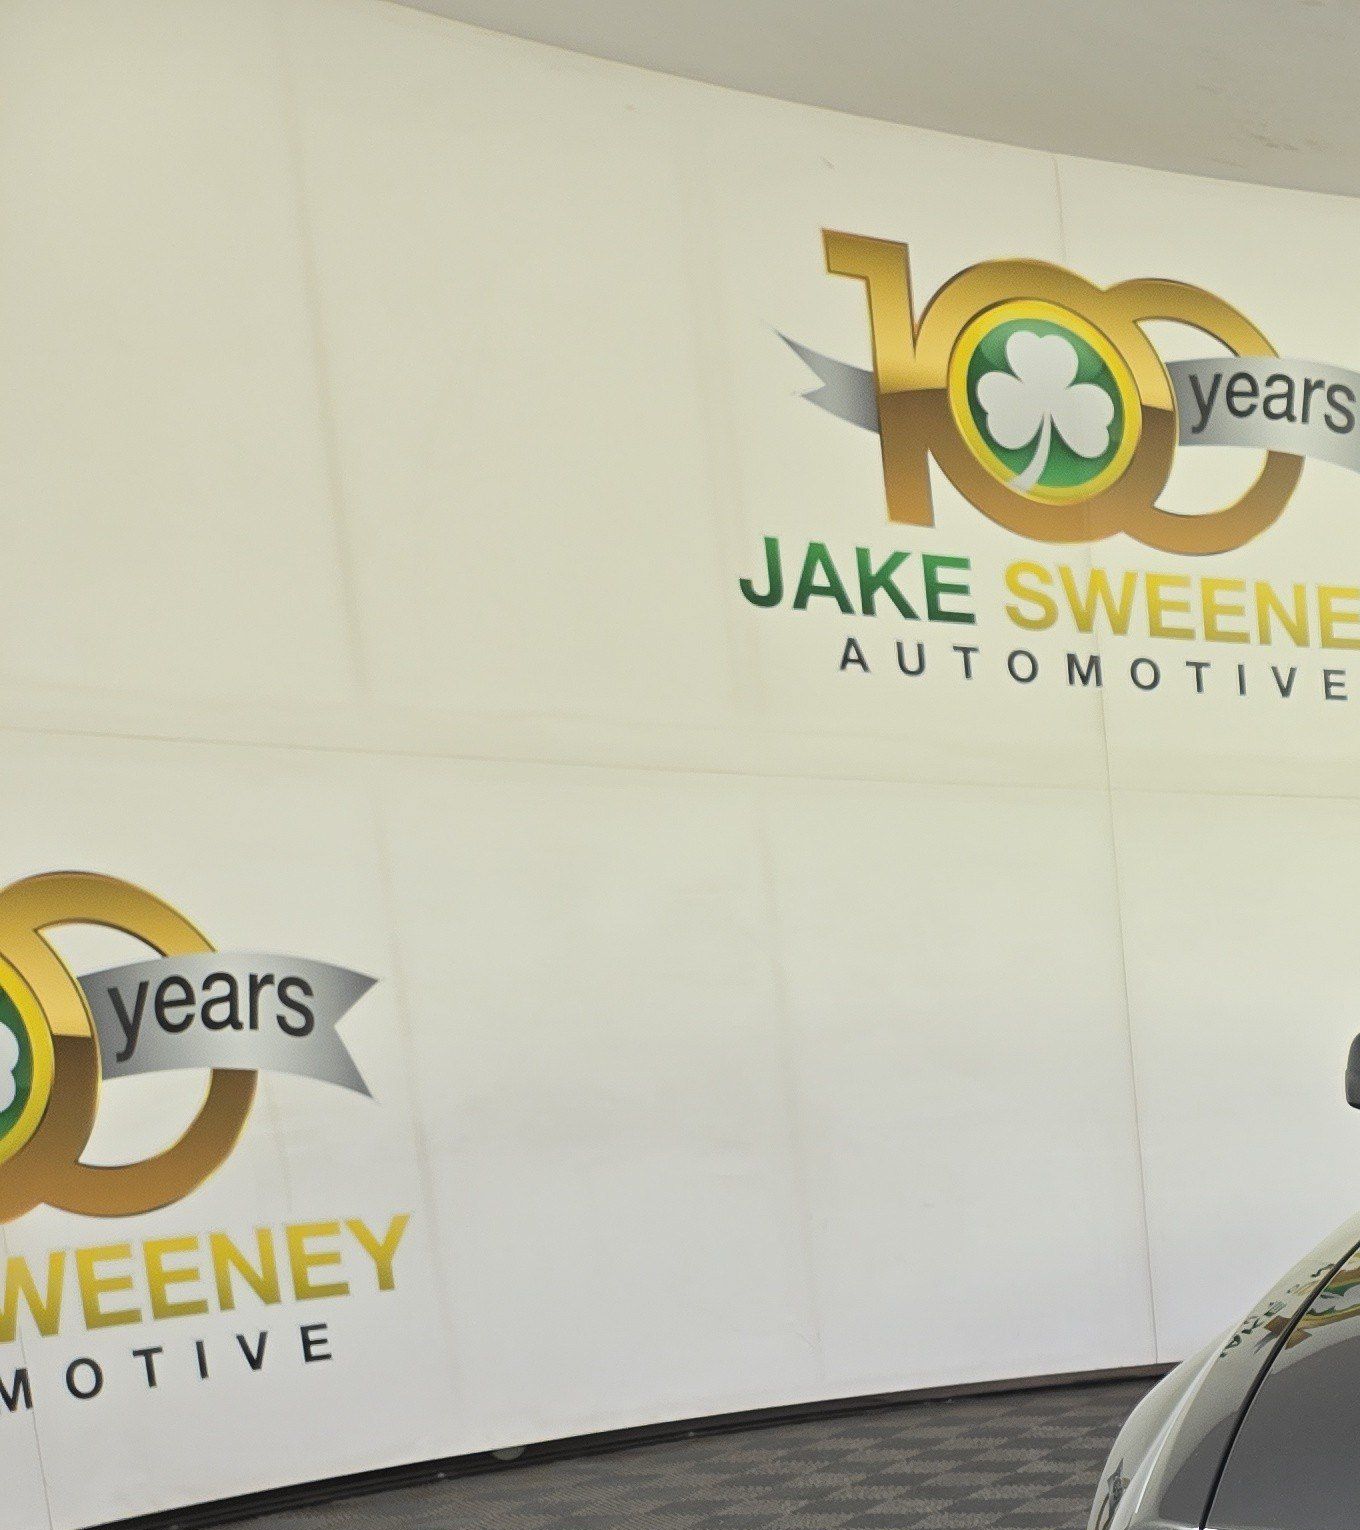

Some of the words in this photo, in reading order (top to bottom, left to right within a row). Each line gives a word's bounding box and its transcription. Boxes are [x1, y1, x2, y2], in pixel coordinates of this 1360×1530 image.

[820, 227, 1305, 557] 100
[1187, 372, 1357, 435] years
[739, 536, 977, 625] JAKE
[838, 636, 1349, 702] AUTOMOTIVE
[106, 971, 316, 1064] years
[0, 1212, 411, 1343] WEENEY
[0, 1322, 334, 1413] MOTIVE
